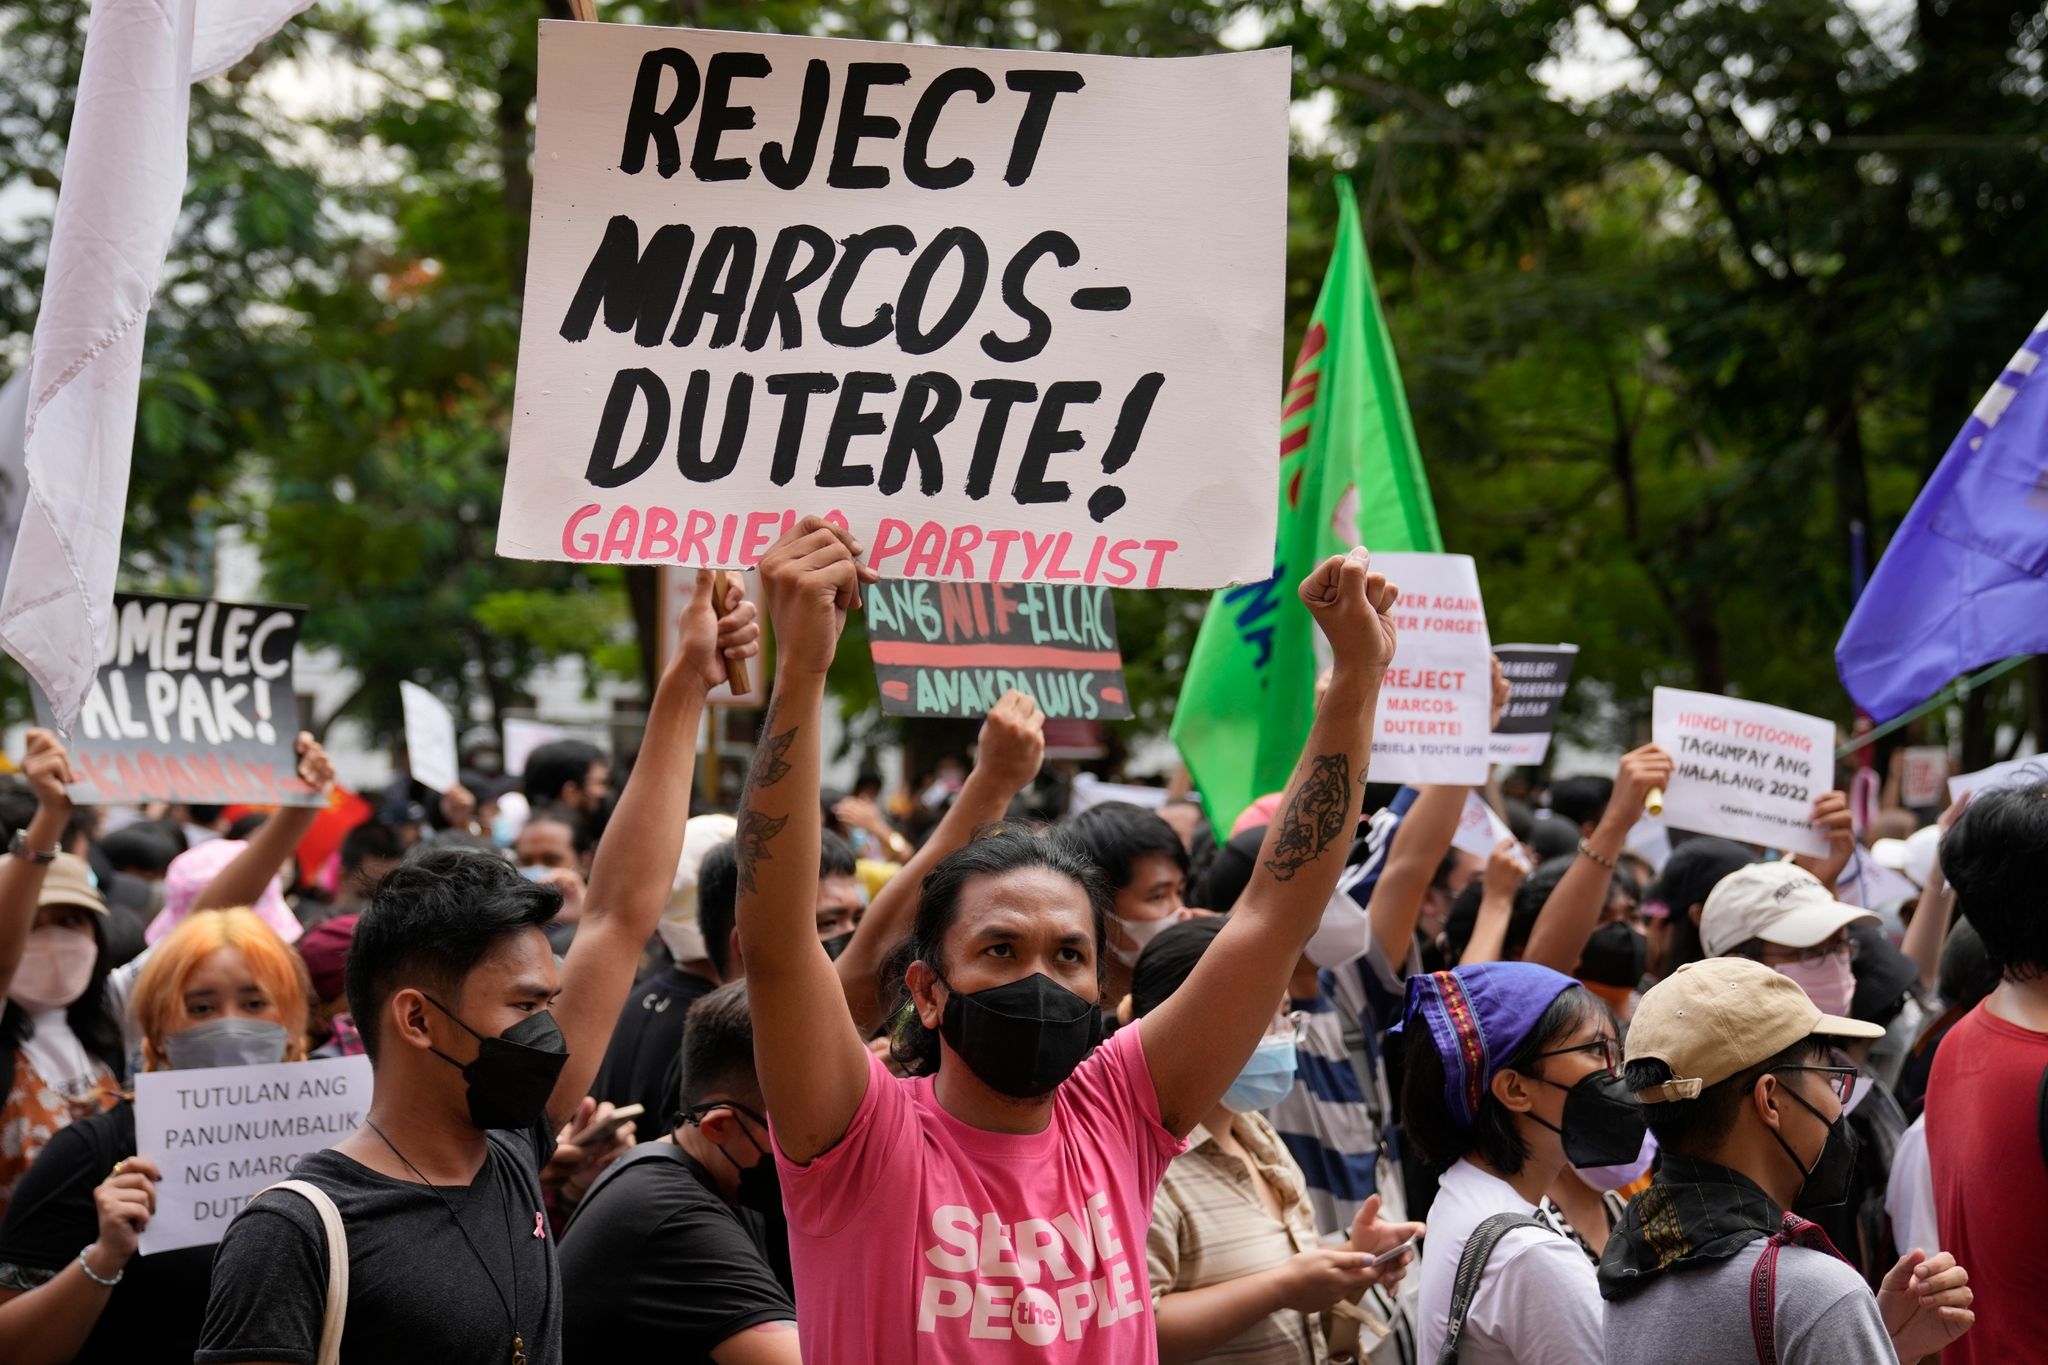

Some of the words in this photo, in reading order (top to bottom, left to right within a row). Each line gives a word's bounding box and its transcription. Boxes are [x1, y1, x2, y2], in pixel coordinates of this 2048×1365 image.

[620, 47, 1085, 190] REJECT
[560, 214, 1131, 363] MARCOS-
[585, 367, 1165, 524] DUTERTE!
[867, 518, 1179, 588] PARTYLIST
[868, 581, 941, 642] ANG
[1432, 595, 1479, 613] AGAIN
[1384, 669, 1466, 691] REJECT
[1386, 698, 1458, 713] MARCOS-
[1384, 720, 1462, 736] DUTERTE!
[1678, 712, 1727, 734] HINDI
[1733, 720, 1813, 753] TOTOONG
[1679, 736, 1771, 767] TAGUMPAY
[1774, 756, 1812, 778] ANG
[1678, 764, 1765, 794] HALALANG
[1769, 781, 1809, 801] 2022
[177, 1082, 290, 1110] TUTULAN
[296, 1076, 348, 1099] ANG
[165, 1112, 358, 1149] PANUNUMBALIK
[185, 1163, 220, 1184] NG
[228, 1154, 299, 1179] MARC
[925, 1191, 1123, 1285] SERVE
[917, 1260, 1145, 1346] PEOPLE
[1016, 1302, 1057, 1326] the
